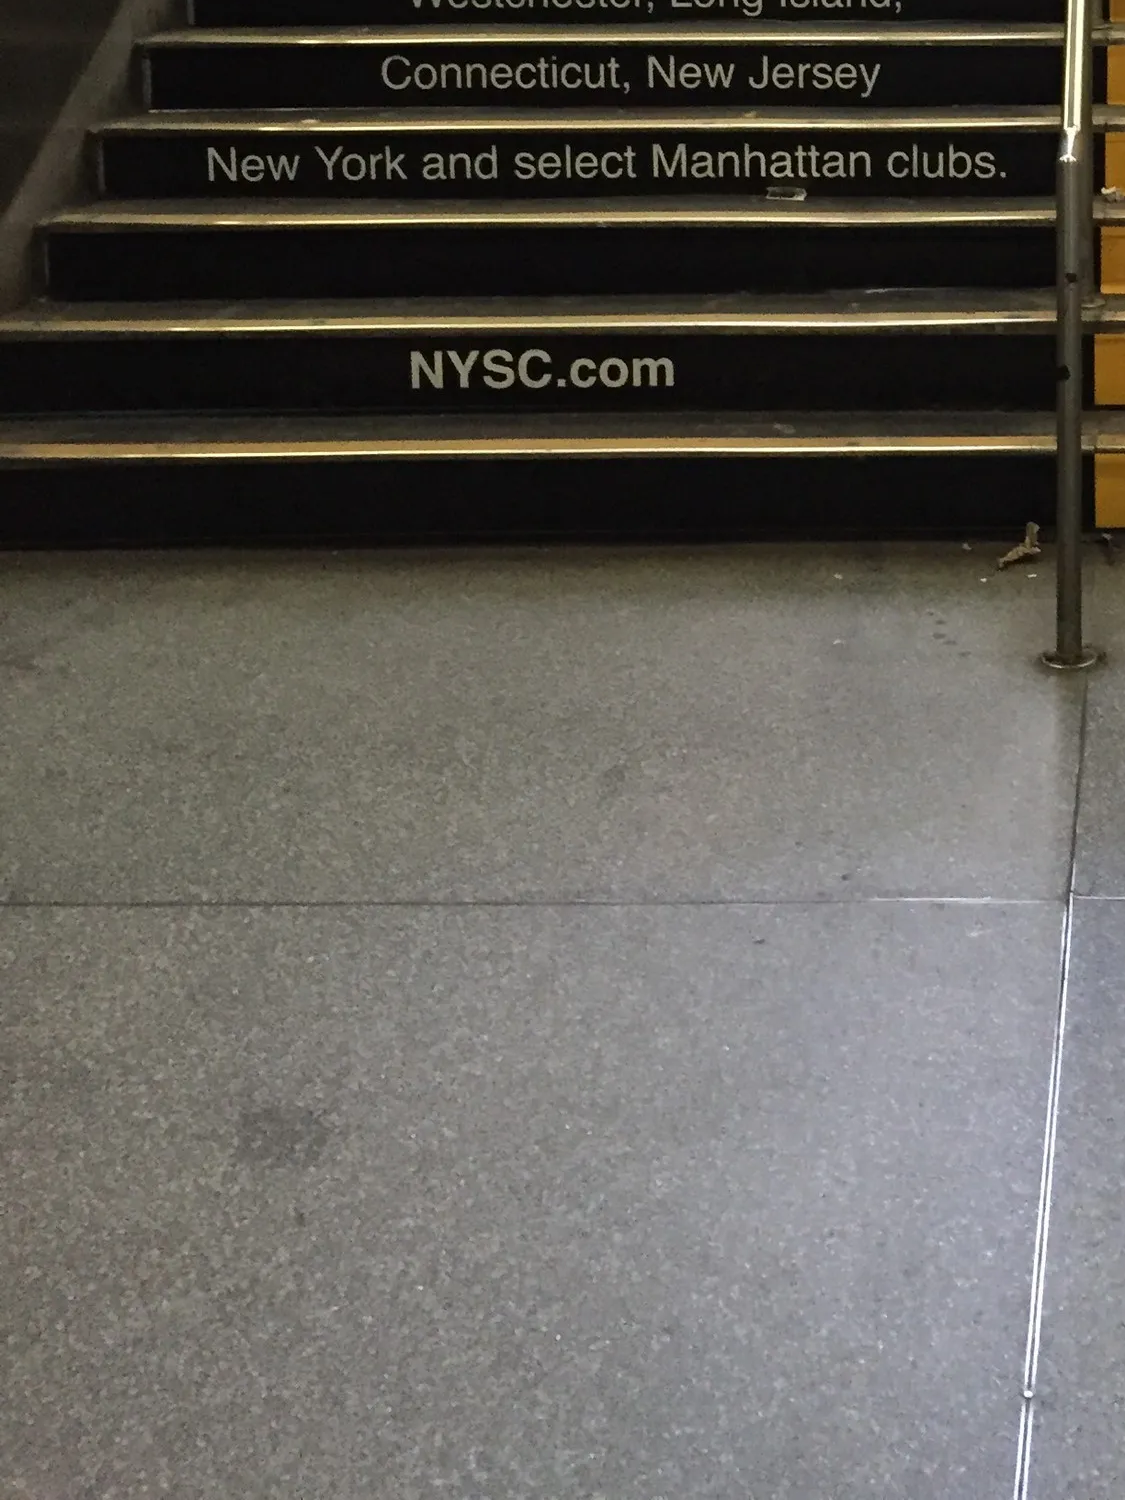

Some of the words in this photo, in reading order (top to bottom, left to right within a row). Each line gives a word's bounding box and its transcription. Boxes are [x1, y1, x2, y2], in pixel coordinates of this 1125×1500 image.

[381, 55, 630, 94] Connecticut,
[647, 56, 735, 89] New
[748, 55, 881, 97] Jersey
[207, 147, 300, 182] New
[314, 146, 407, 181] York
[423, 145, 498, 181] and
[514, 144, 637, 180] select
[652, 143, 873, 179] Manhattan
[887, 141, 1008, 178] clubs.
[410, 349, 676, 390] NYSC.com
